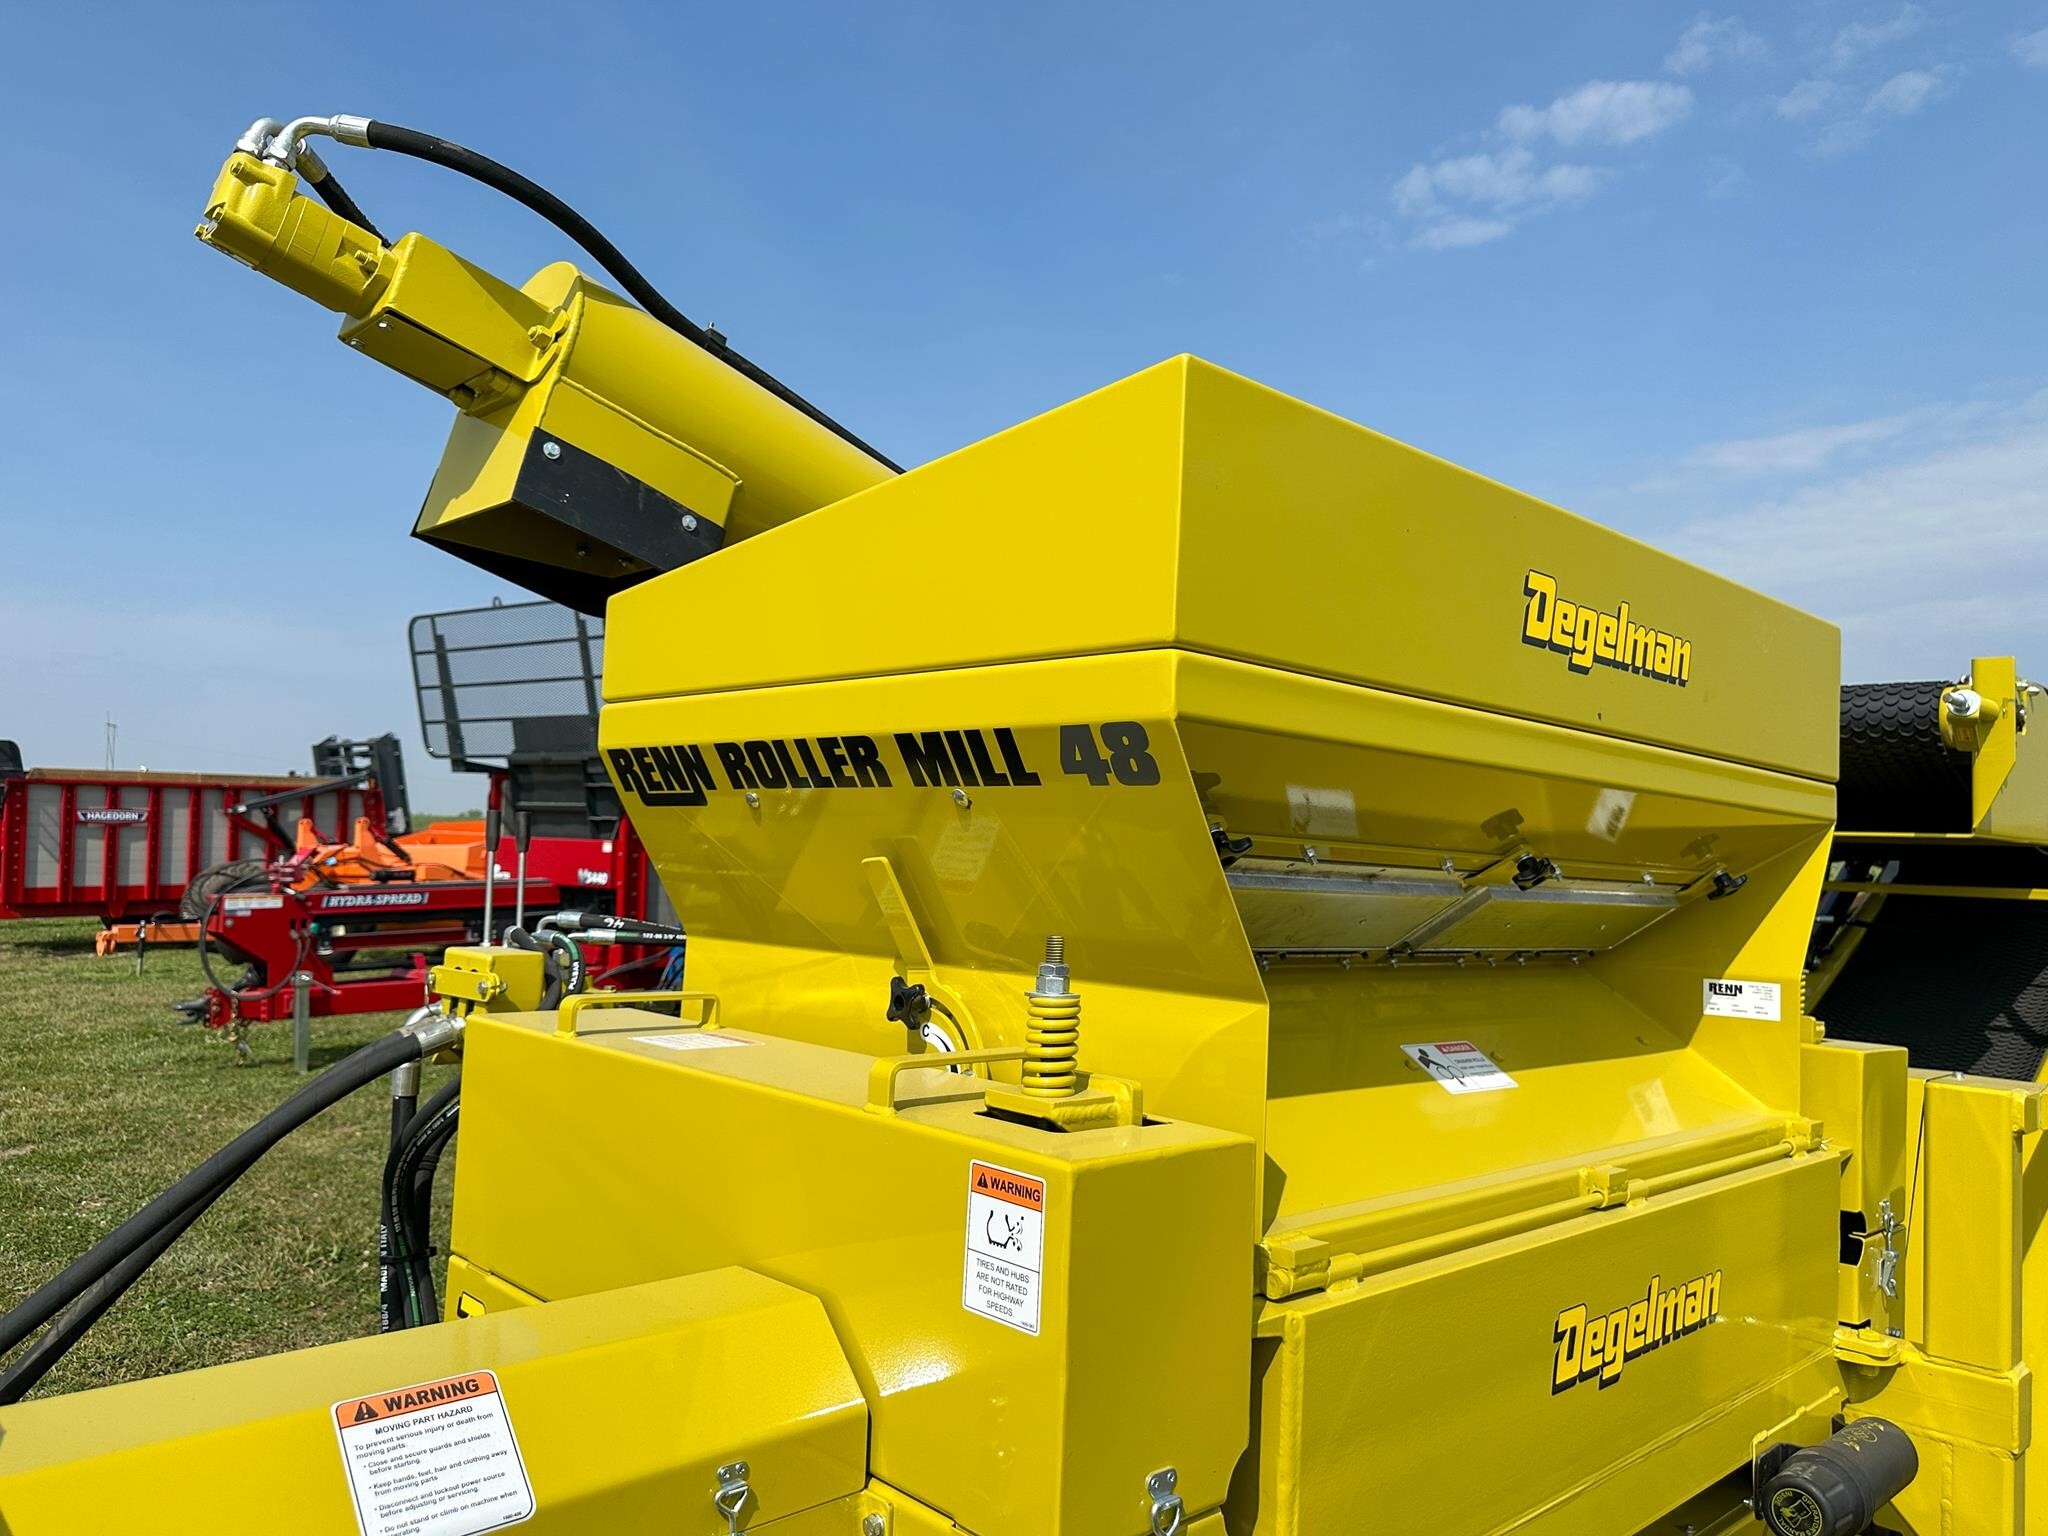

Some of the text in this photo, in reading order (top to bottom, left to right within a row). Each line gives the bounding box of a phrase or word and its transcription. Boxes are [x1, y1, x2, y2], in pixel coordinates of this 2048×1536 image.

[1522, 569, 1692, 687] Degelman
[607, 721, 1161, 806] RENN ROLLER MILL 48
[87, 811, 139, 820] HAGEDORN
[328, 893, 422, 907] HYDRA-SPREAD
[567, 961, 580, 990] PULSAR
[1709, 982, 1743, 996] RENN
[922, 1023, 930, 1037] C
[990, 1176, 1041, 1202] WARNING
[380, 1263, 388, 1292] MADE
[975, 1271, 1028, 1296] ARE NOT RATED
[976, 1258, 1030, 1284] TIRES AND HUBS
[978, 1284, 1025, 1308] FOR HIGHWAY
[1551, 1269, 1722, 1396] Degelman
[383, 1379, 480, 1413] WARNING
[354, 1412, 494, 1452] To prevent serious injury or death from
[374, 1405, 473, 1435] MOVING PART HAZARD
[356, 1447, 385, 1460] moving
[367, 1432, 491, 1469] Close and secure guards and shields
[369, 1464, 392, 1475] before
[373, 1480, 392, 1490] Keep
[434, 1464, 448, 1473] hair
[449, 1461, 462, 1470] and
[463, 1454, 490, 1466] clothing
[491, 1450, 508, 1460] away
[374, 1487, 392, 1497] from
[392, 1481, 420, 1492] moving
[378, 1471, 506, 1511] Disconnect and lockout power source
[380, 1508, 403, 1519] before
[404, 1499, 438, 1512] adjusting
[384, 1524, 395, 1534] Do
[396, 1520, 409, 1530] not
[410, 1515, 430, 1527] stand
[439, 1506, 459, 1518] climb
[460, 1503, 470, 1511] on
[470, 1496, 499, 1508] machine
[499, 1489, 518, 1500] when
